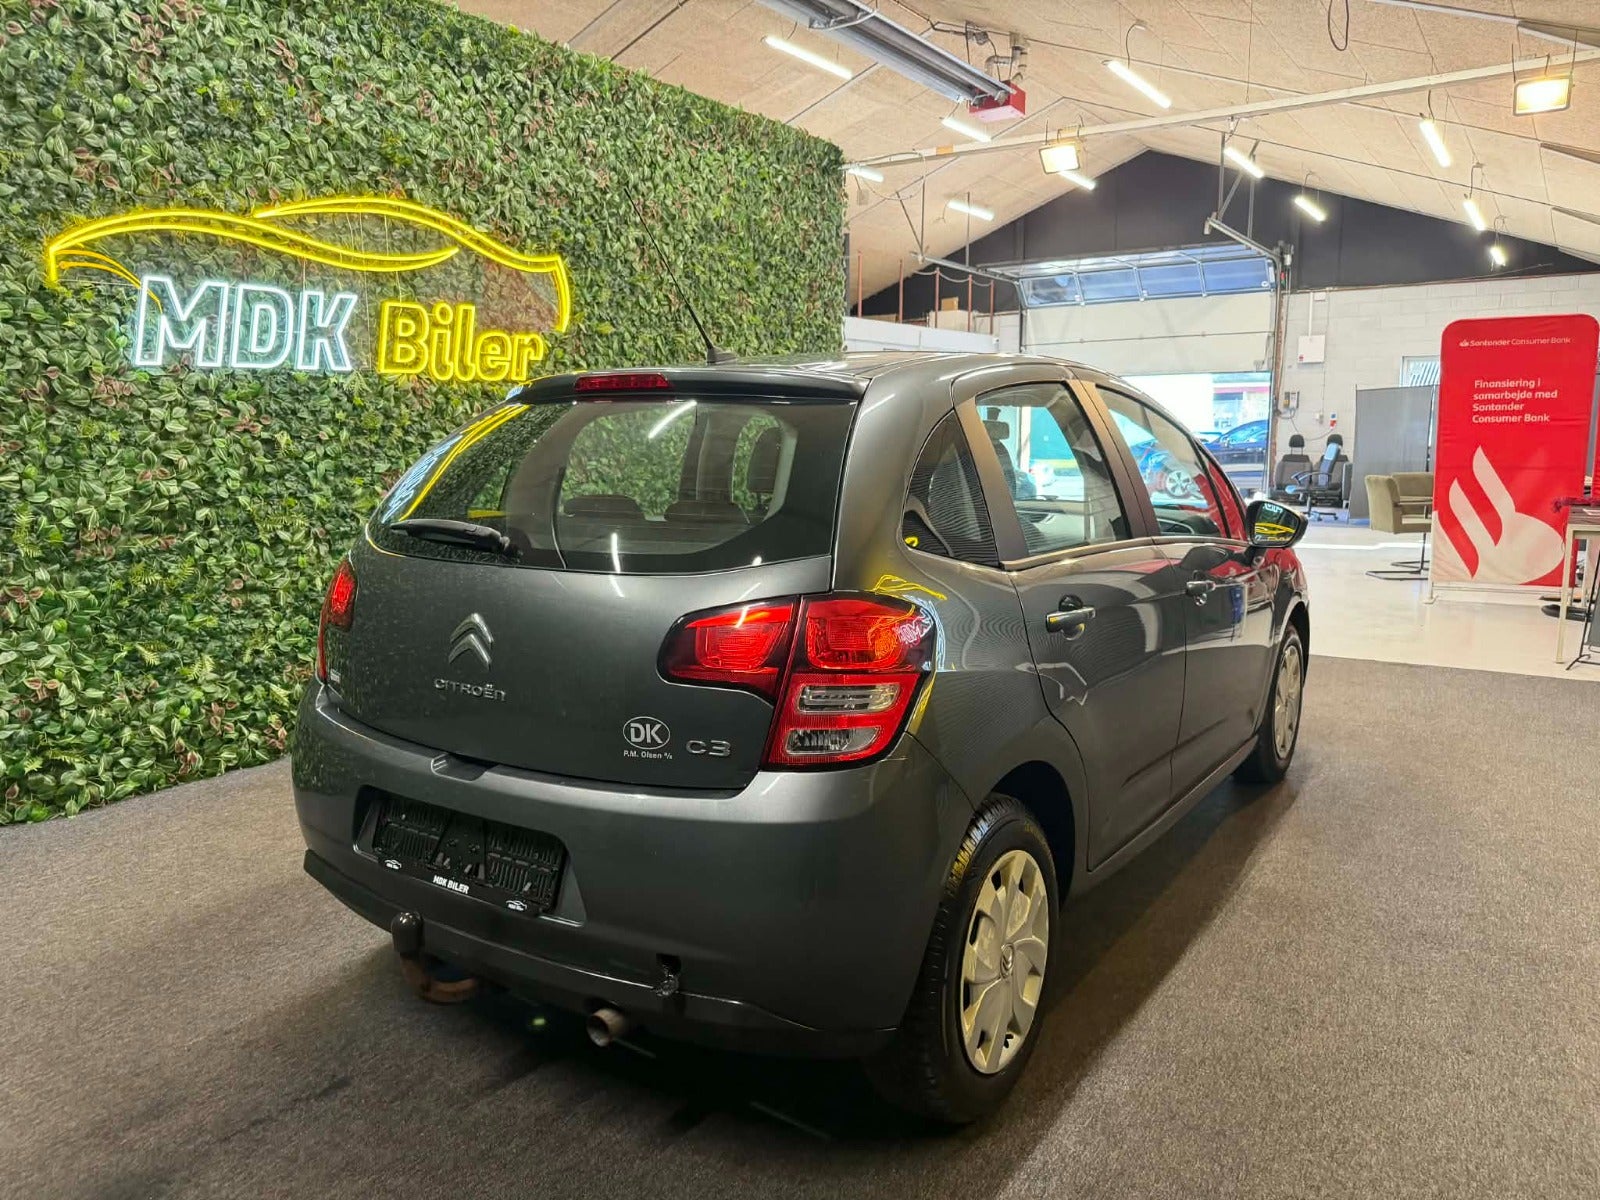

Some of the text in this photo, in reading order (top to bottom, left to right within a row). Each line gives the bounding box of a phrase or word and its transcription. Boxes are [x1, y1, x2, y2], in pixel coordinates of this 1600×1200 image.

[133, 274, 544, 382] MDK Biler
[1470, 339, 1510, 347] Santander
[1474, 379, 1536, 390] Finansiering
[1473, 390, 1558, 401] samarbejde med
[1472, 402, 1525, 412] Santander
[1472, 413, 1550, 424] Consumer Bank
[630, 722, 663, 743] DK
[686, 740, 731, 757] C3
[641, 751, 662, 759] Olsen
[447, 880, 470, 894] BILER
